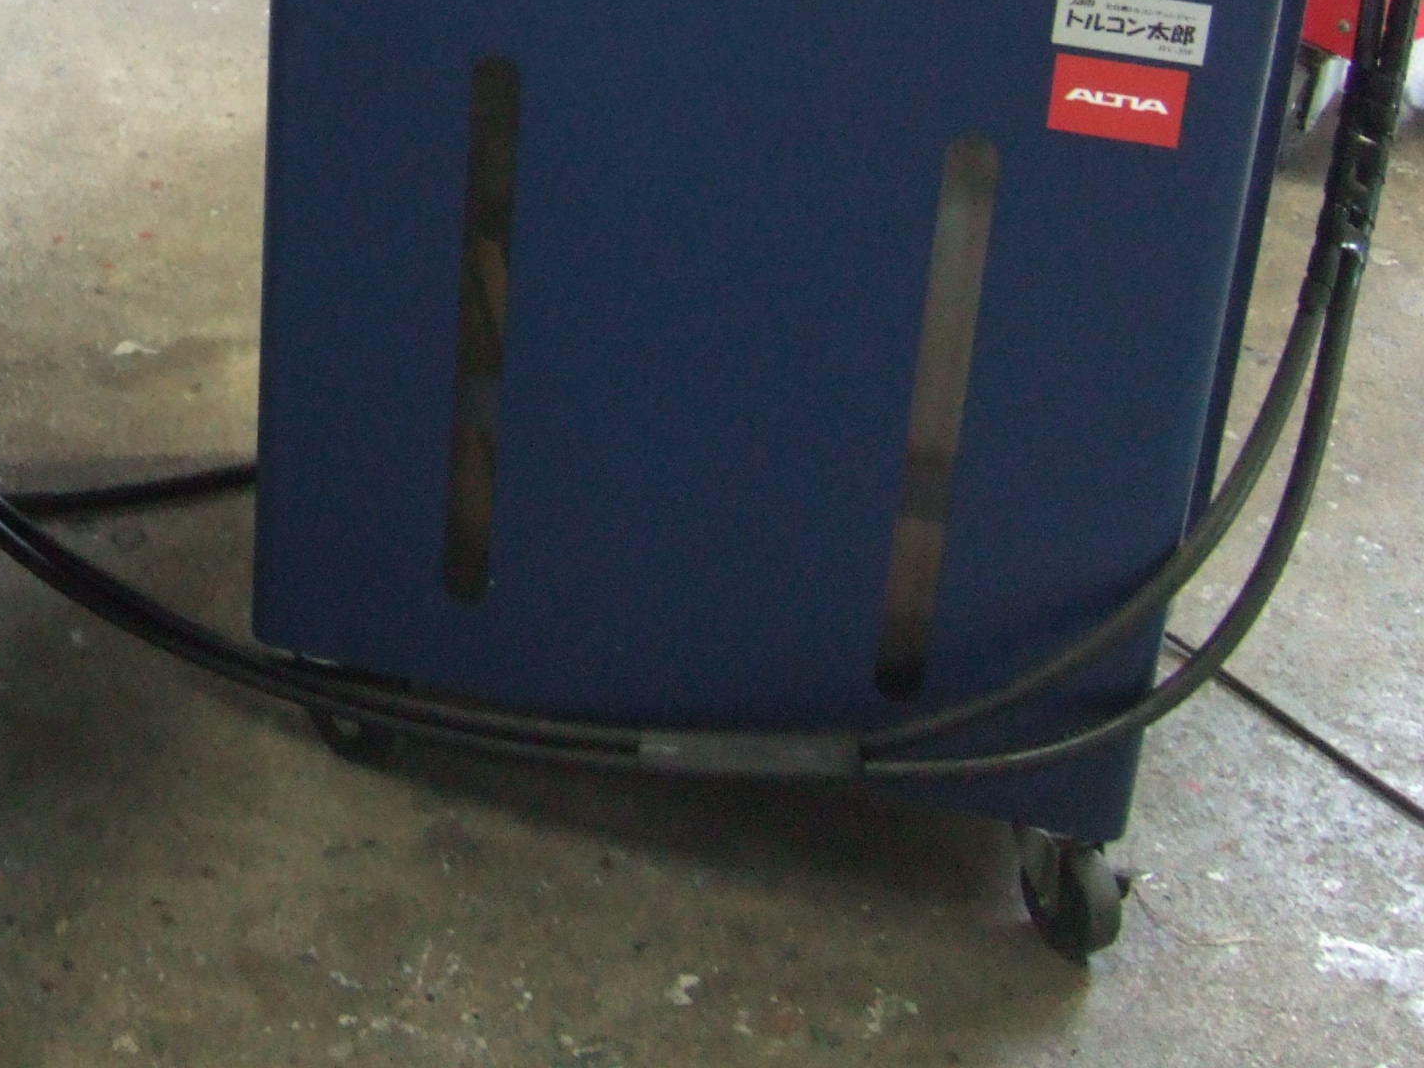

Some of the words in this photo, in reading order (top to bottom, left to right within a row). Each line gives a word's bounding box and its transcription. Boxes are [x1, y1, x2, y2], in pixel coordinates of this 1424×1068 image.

[1066, 9, 1197, 45] トルコン太郎
